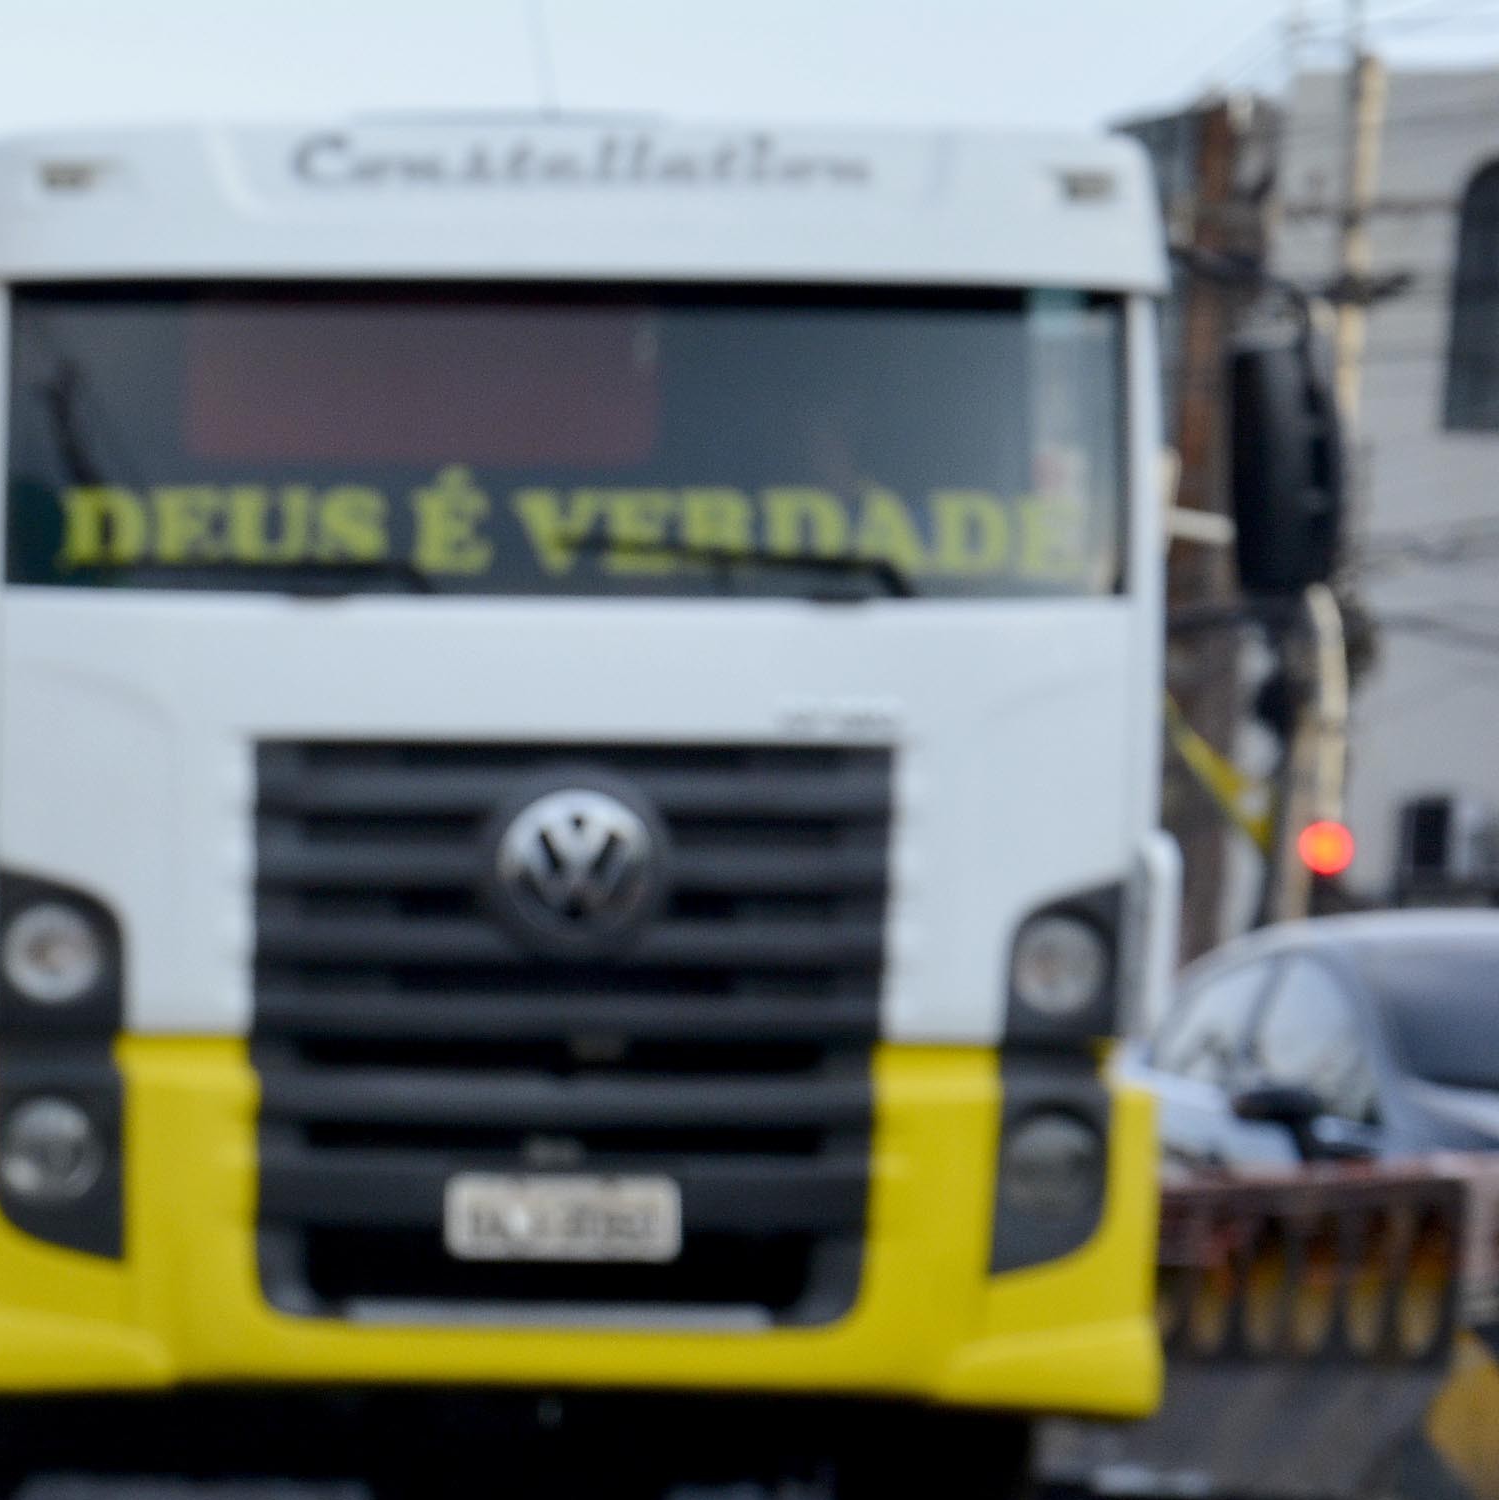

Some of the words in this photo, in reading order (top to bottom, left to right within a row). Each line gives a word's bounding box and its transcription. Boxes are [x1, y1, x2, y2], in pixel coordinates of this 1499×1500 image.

[291, 130, 873, 190] Constellation
[61, 484, 393, 568] DEUS
[413, 463, 495, 576] É
[511, 486, 1083, 578] VERDADE
